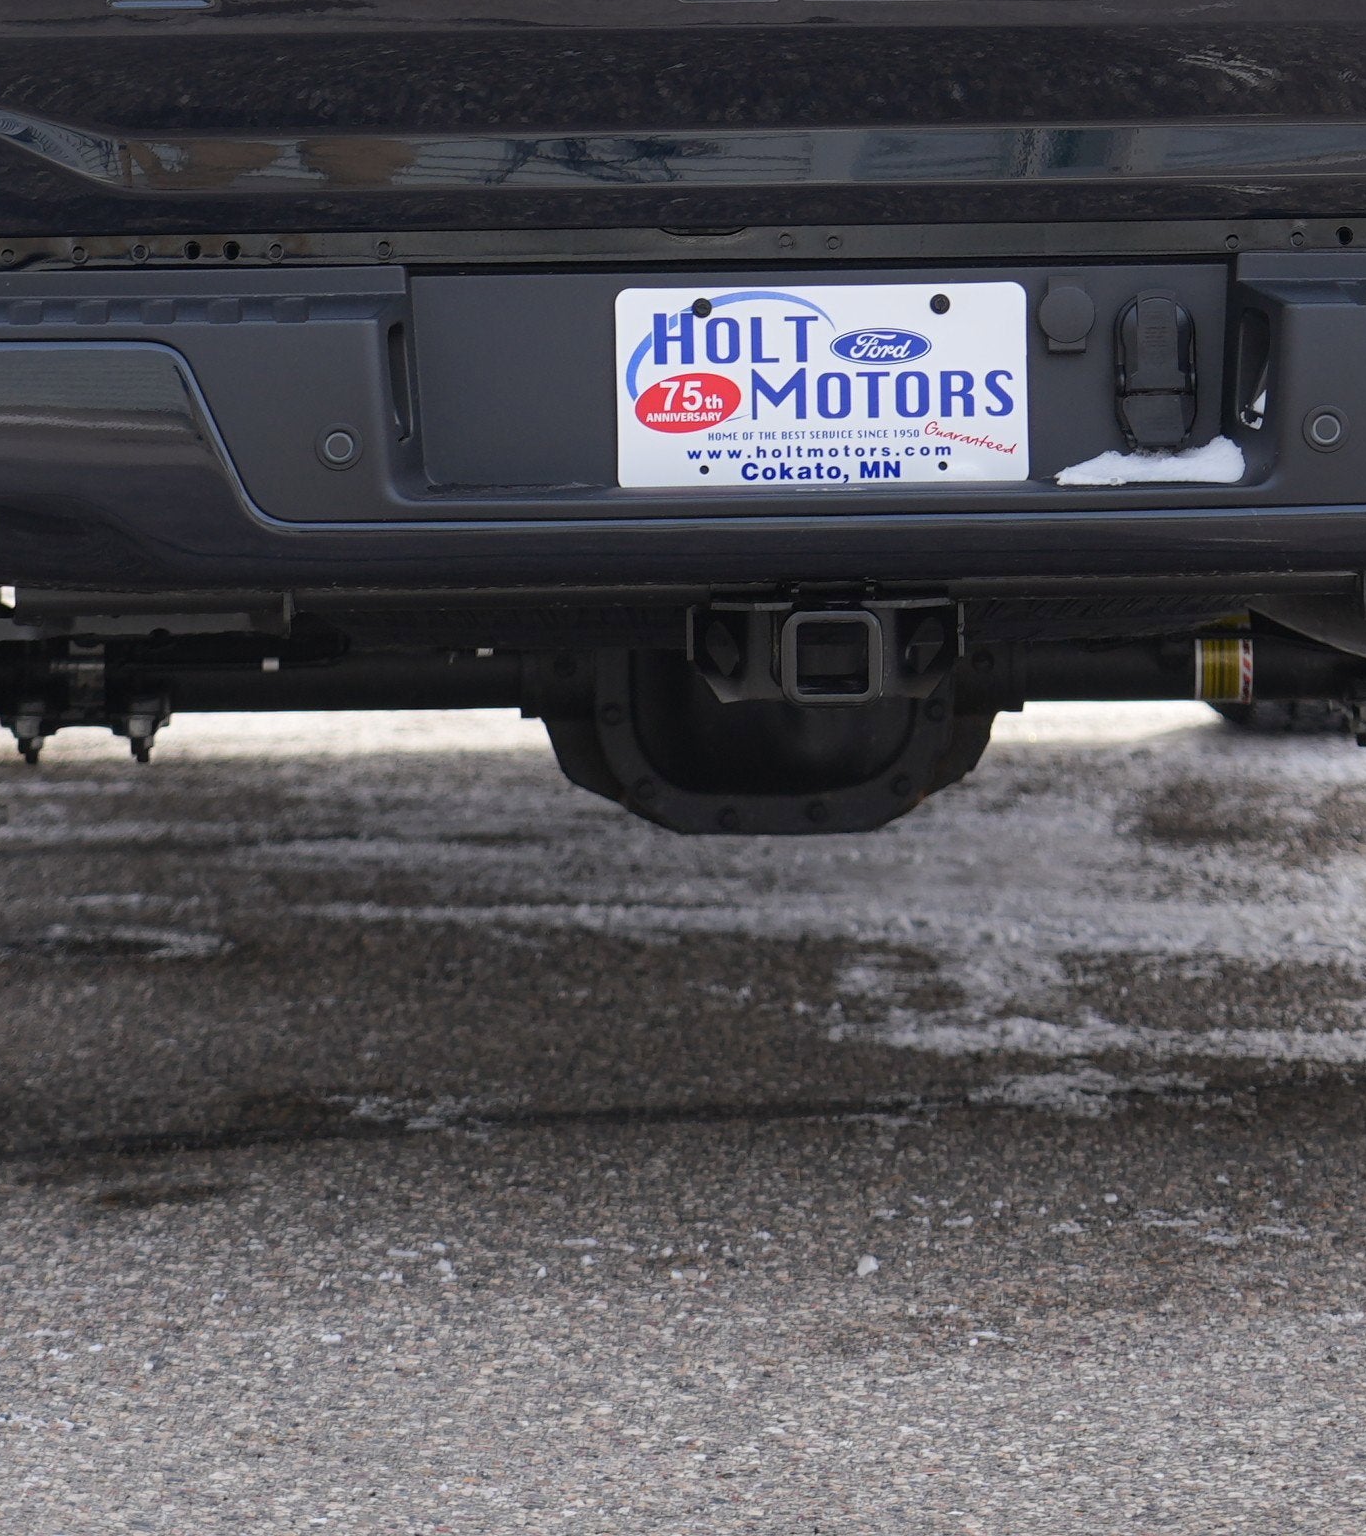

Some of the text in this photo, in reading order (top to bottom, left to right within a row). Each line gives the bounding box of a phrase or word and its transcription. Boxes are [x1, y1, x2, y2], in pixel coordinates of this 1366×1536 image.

[653, 313, 819, 365] HOLT
[849, 332, 913, 359] Ford
[659, 380, 724, 412] 75th
[751, 367, 1015, 421] MOTORS
[646, 411, 723, 423] ANNIVERSARY
[707, 429, 920, 441] HOME OF THE BEST SERVICE SINCE 1950
[924, 420, 1017, 455] Guaranteed
[687, 445, 952, 460] www.holtmotors.com
[741, 461, 901, 484] Cokato, MN
